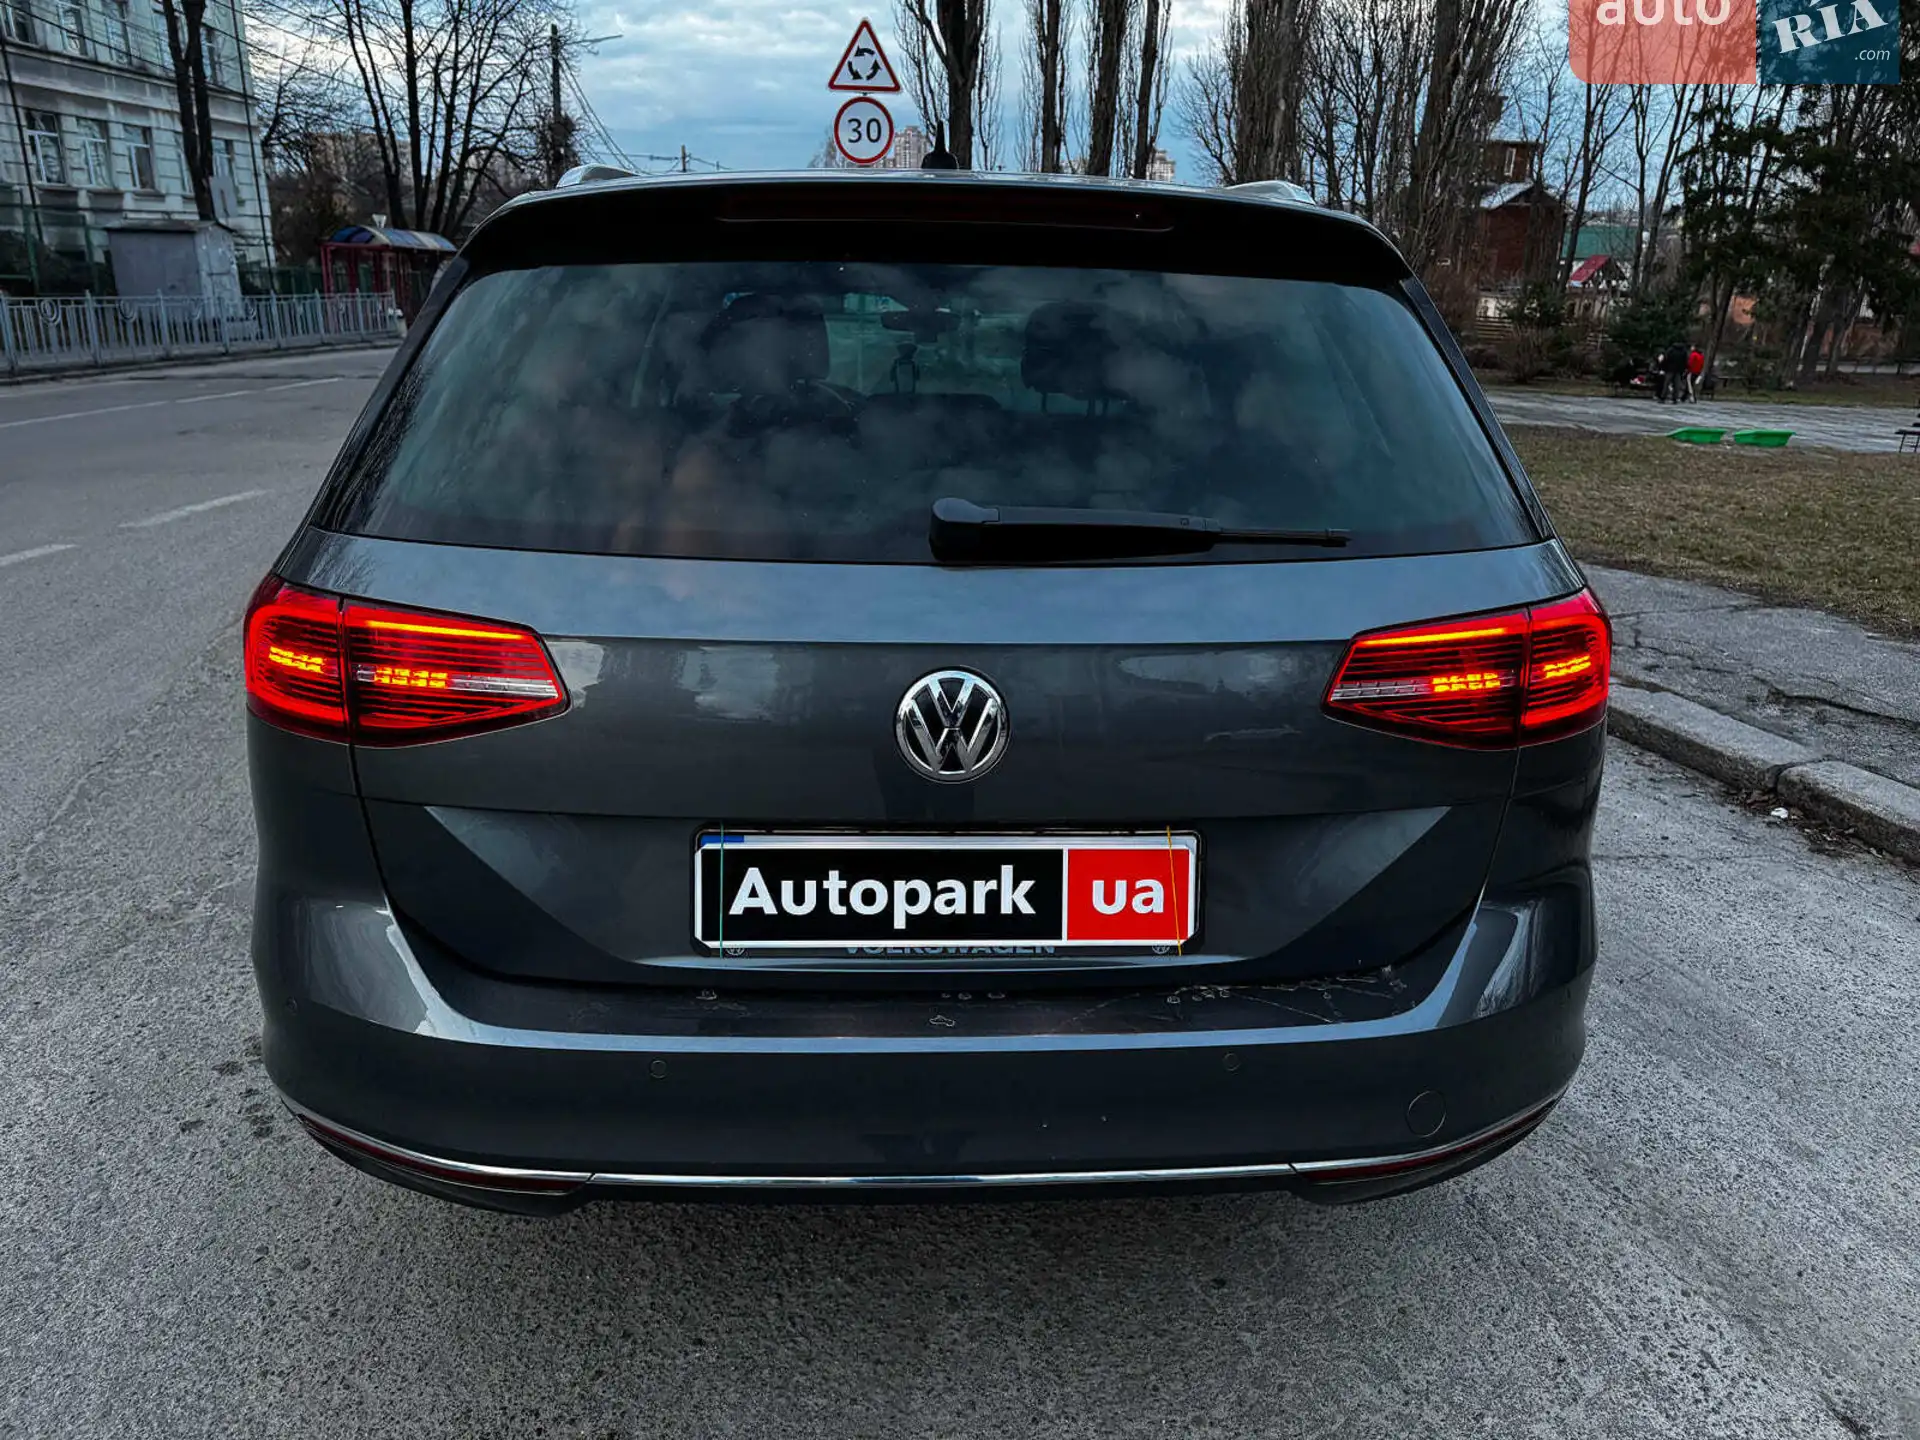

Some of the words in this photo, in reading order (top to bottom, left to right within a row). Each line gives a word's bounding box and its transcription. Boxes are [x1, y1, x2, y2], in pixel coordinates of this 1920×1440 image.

[847, 117, 882, 144] 30
[728, 865, 1037, 930] Autopark
[1091, 877, 1165, 915] ua
